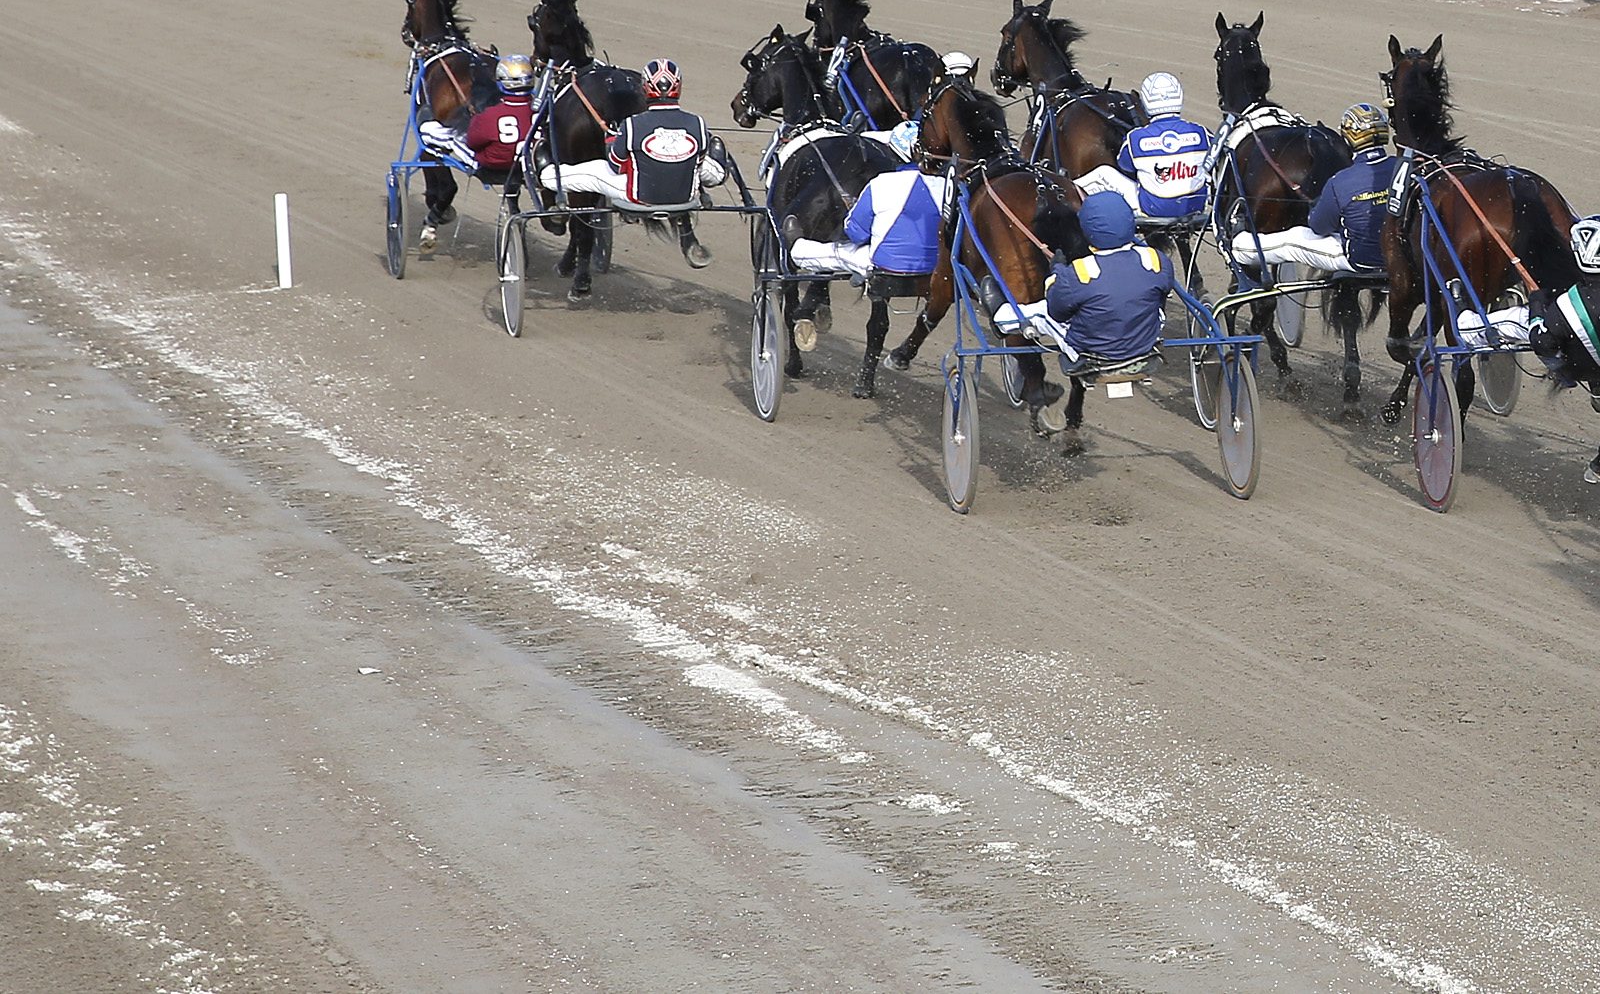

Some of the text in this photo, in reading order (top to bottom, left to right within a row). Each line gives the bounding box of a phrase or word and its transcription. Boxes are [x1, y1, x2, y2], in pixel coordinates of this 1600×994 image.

[1033, 94, 1045, 126] 2
[498, 115, 519, 143] S
[1210, 124, 1228, 158] 3
[945, 165, 956, 205] 6
[1168, 160, 1198, 181] Mira
[1392, 161, 1409, 200] 4
